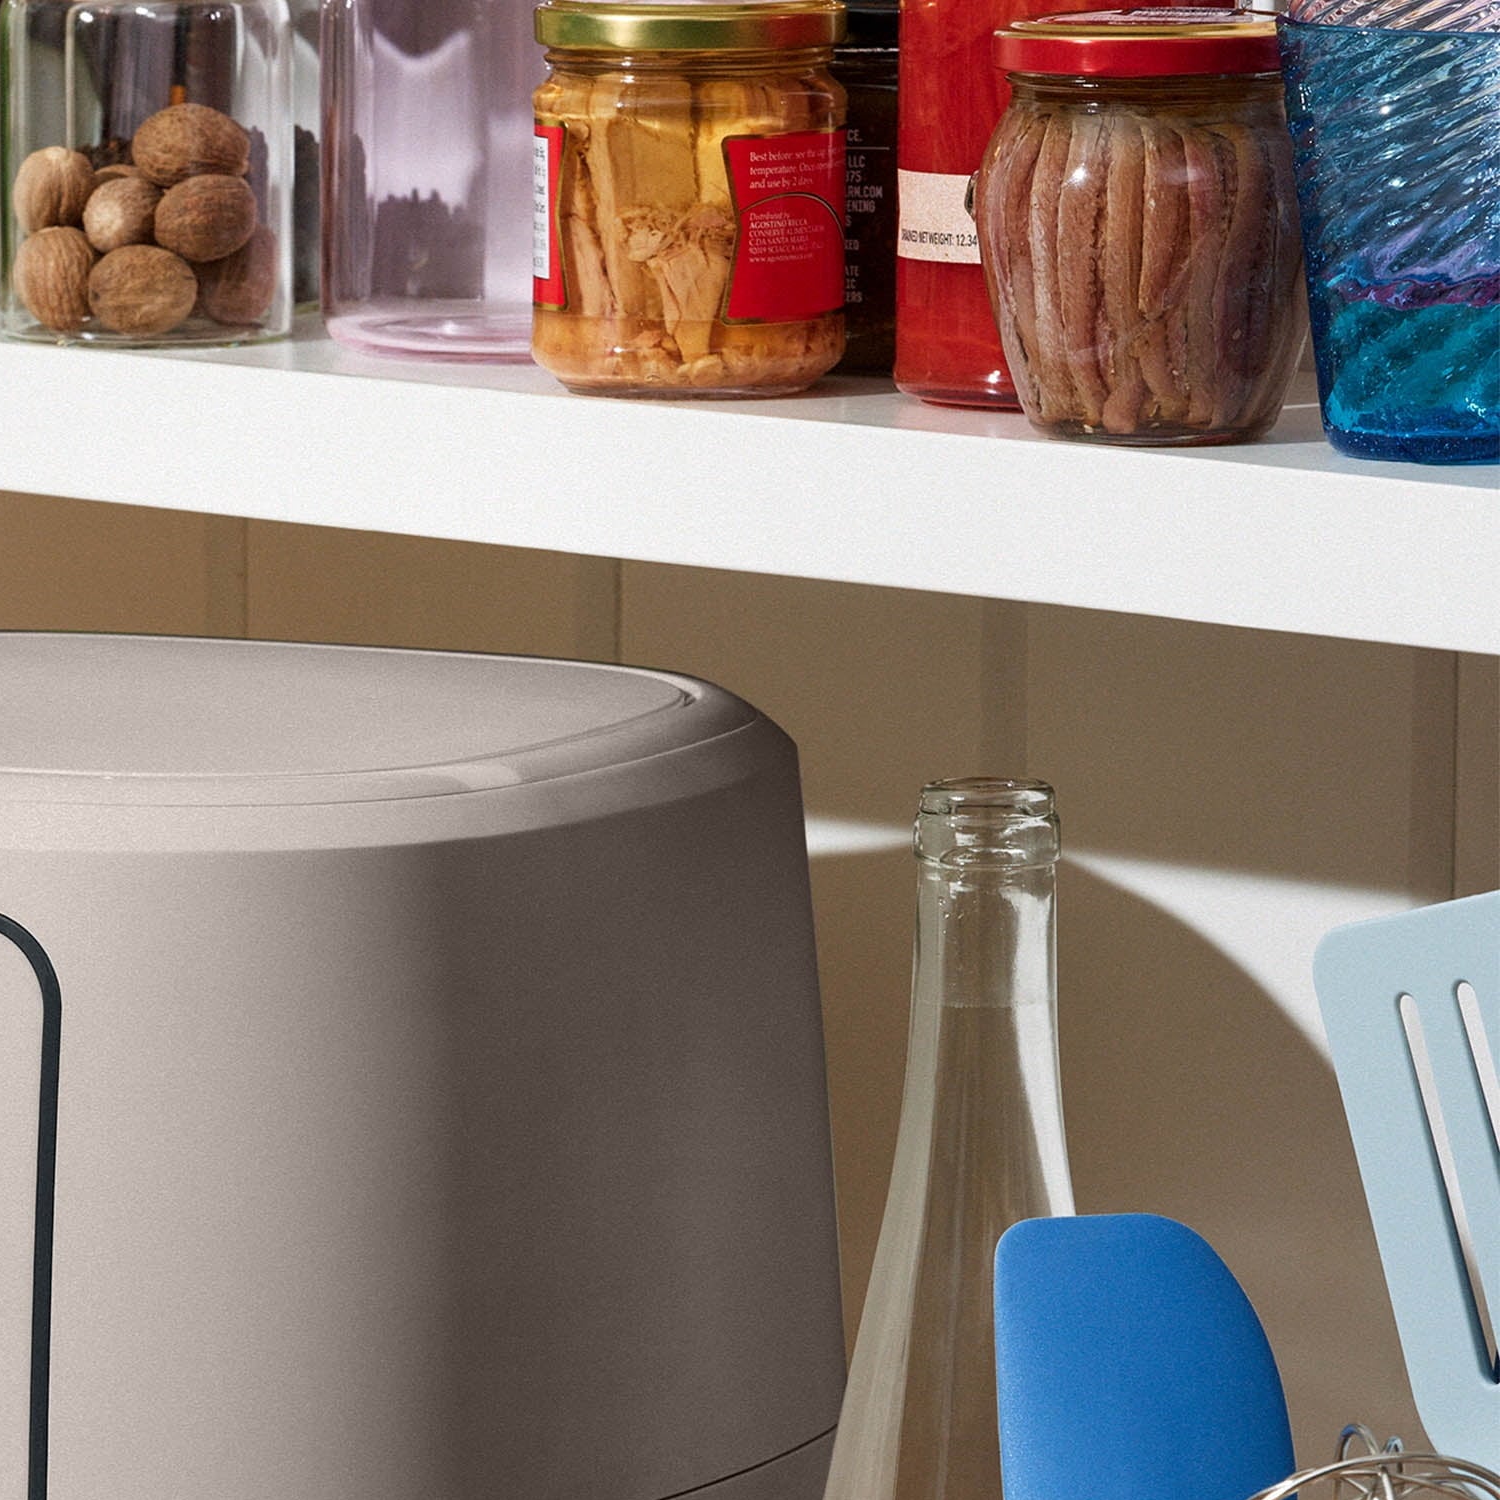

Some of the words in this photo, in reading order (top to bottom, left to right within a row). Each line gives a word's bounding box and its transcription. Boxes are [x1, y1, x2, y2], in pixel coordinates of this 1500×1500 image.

[749, 151, 767, 162] Best
[847, 155, 866, 168] LLC
[749, 179, 766, 189] and
